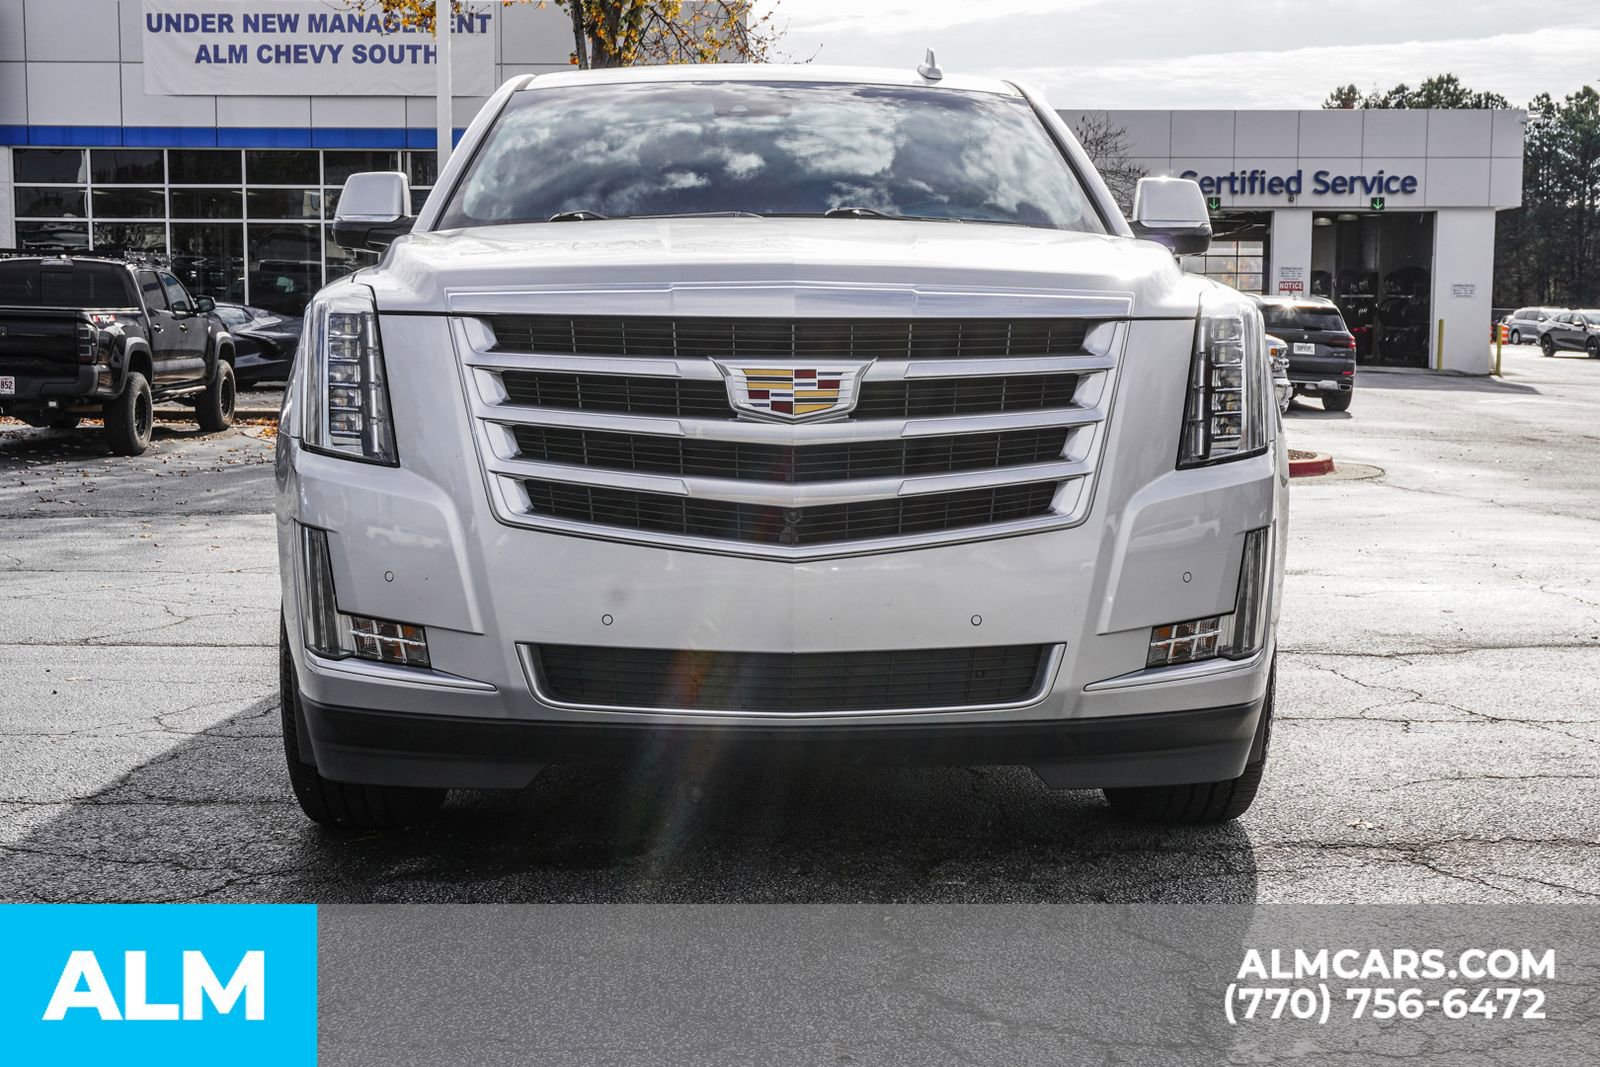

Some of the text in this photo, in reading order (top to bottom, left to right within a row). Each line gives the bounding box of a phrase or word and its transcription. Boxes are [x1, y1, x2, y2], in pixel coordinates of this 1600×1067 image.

[146, 13, 234, 33] UNDER
[243, 13, 300, 33] NEW
[195, 44, 437, 64] ALM CHEVY SOUTH
[1312, 169, 1418, 195] Service
[1279, 282, 1303, 290] NOTICE
